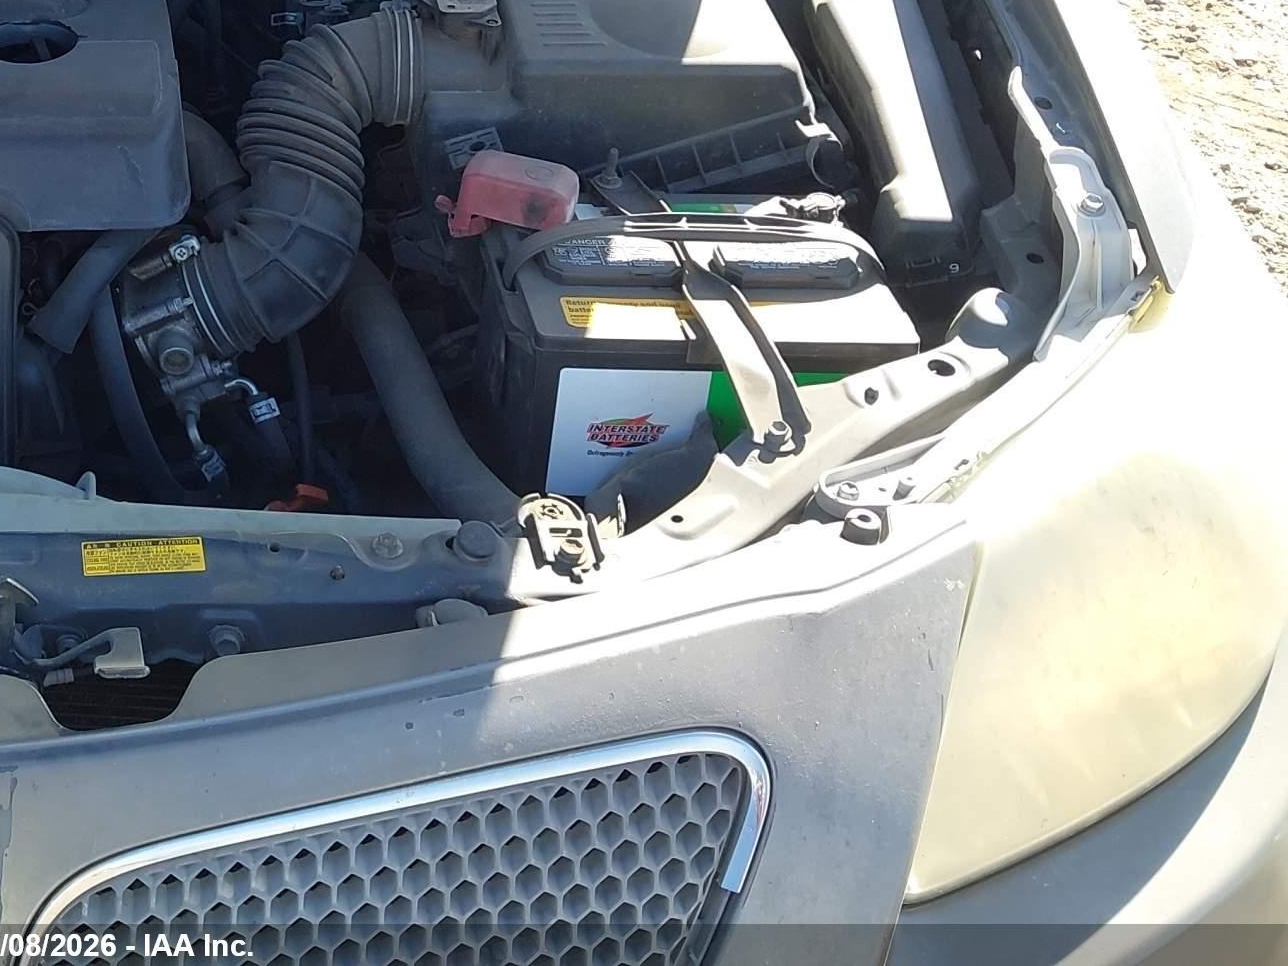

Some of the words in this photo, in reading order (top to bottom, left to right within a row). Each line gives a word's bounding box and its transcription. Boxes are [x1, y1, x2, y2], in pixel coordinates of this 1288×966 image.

[949, 263, 960, 273] 9
[588, 425, 665, 433] INTERSTATE
[588, 434, 658, 442] BATTERIES
